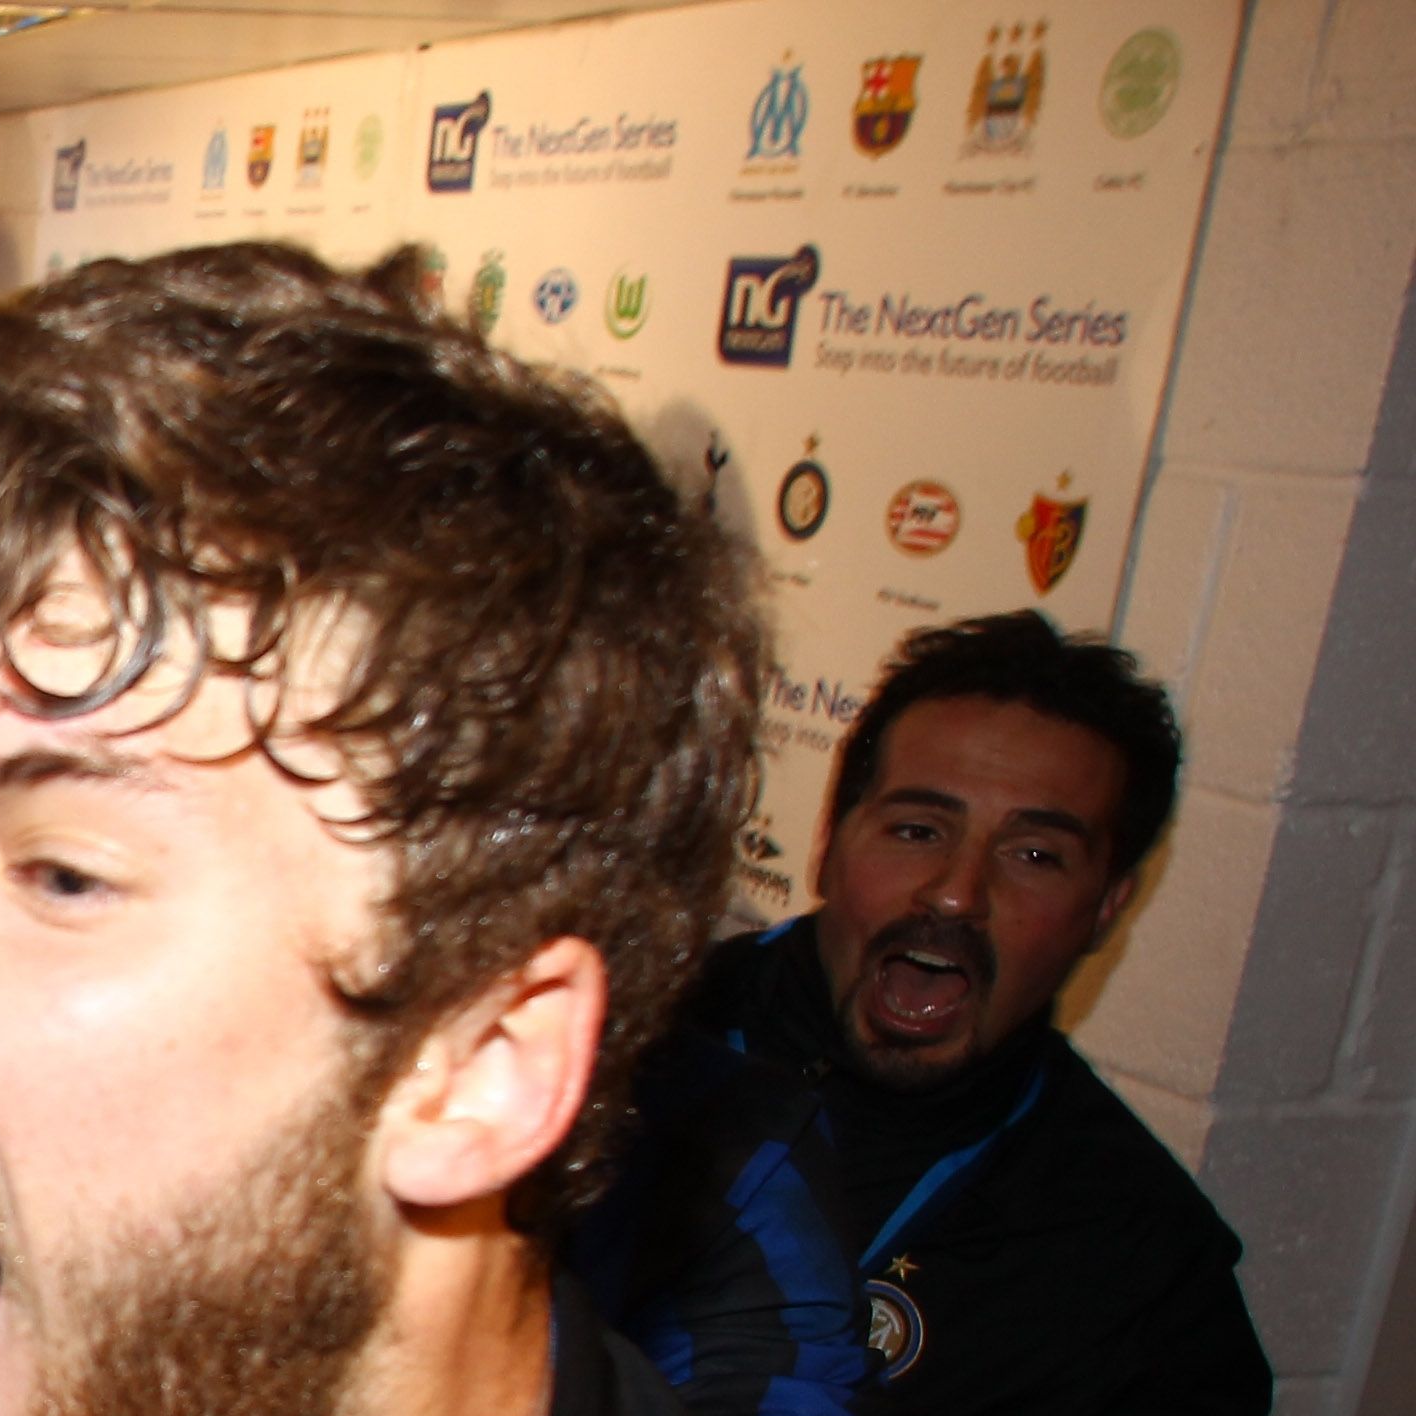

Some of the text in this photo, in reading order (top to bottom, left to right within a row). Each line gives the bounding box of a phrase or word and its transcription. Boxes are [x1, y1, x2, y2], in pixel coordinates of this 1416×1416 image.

[819, 291, 1129, 347] The NextGen Series
[814, 343, 852, 376] Step
[858, 346, 896, 373] into
[900, 346, 934, 375] the
[937, 346, 1000, 380] future
[1030, 353, 1119, 387] football
